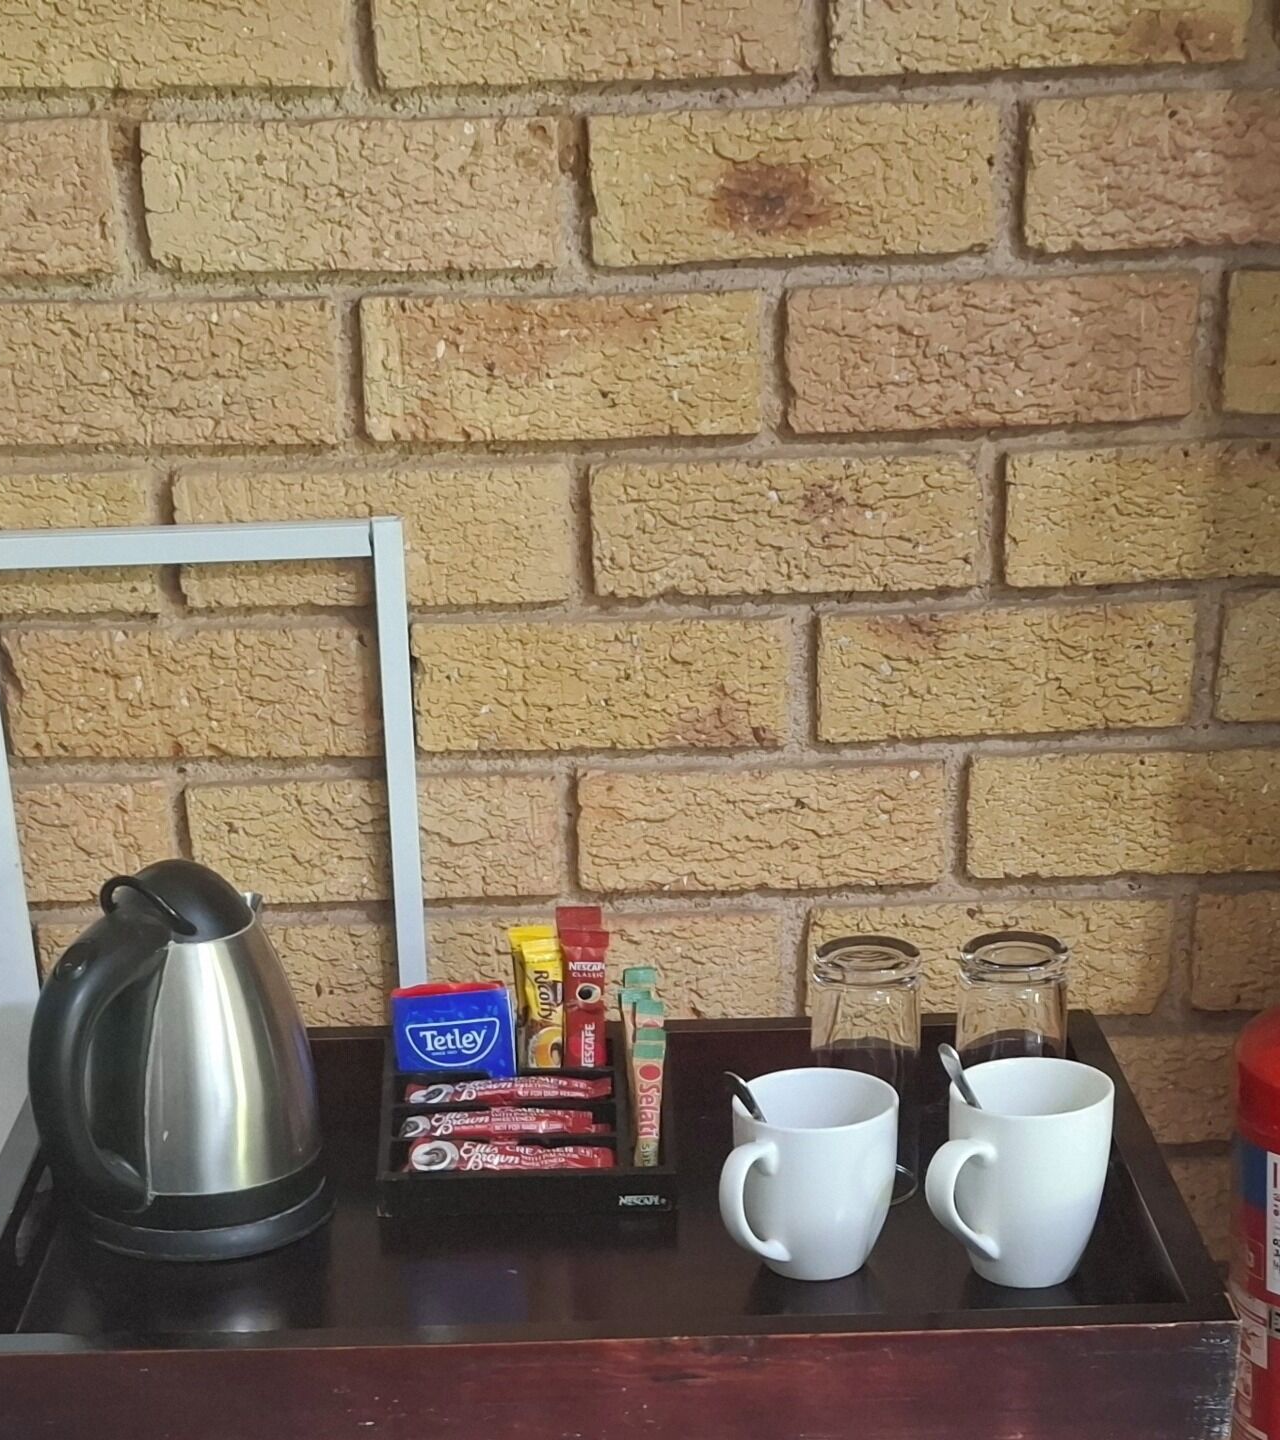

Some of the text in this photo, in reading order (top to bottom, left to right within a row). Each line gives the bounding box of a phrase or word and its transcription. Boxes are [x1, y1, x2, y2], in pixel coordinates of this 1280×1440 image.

[533, 969, 556, 1021] Ricoffy
[419, 1028, 487, 1055] Tetley
[638, 1083, 660, 1138] Selati
[432, 1116, 489, 1136] Brown
[460, 1141, 500, 1157] Ellis
[460, 1151, 520, 1170] Brown
